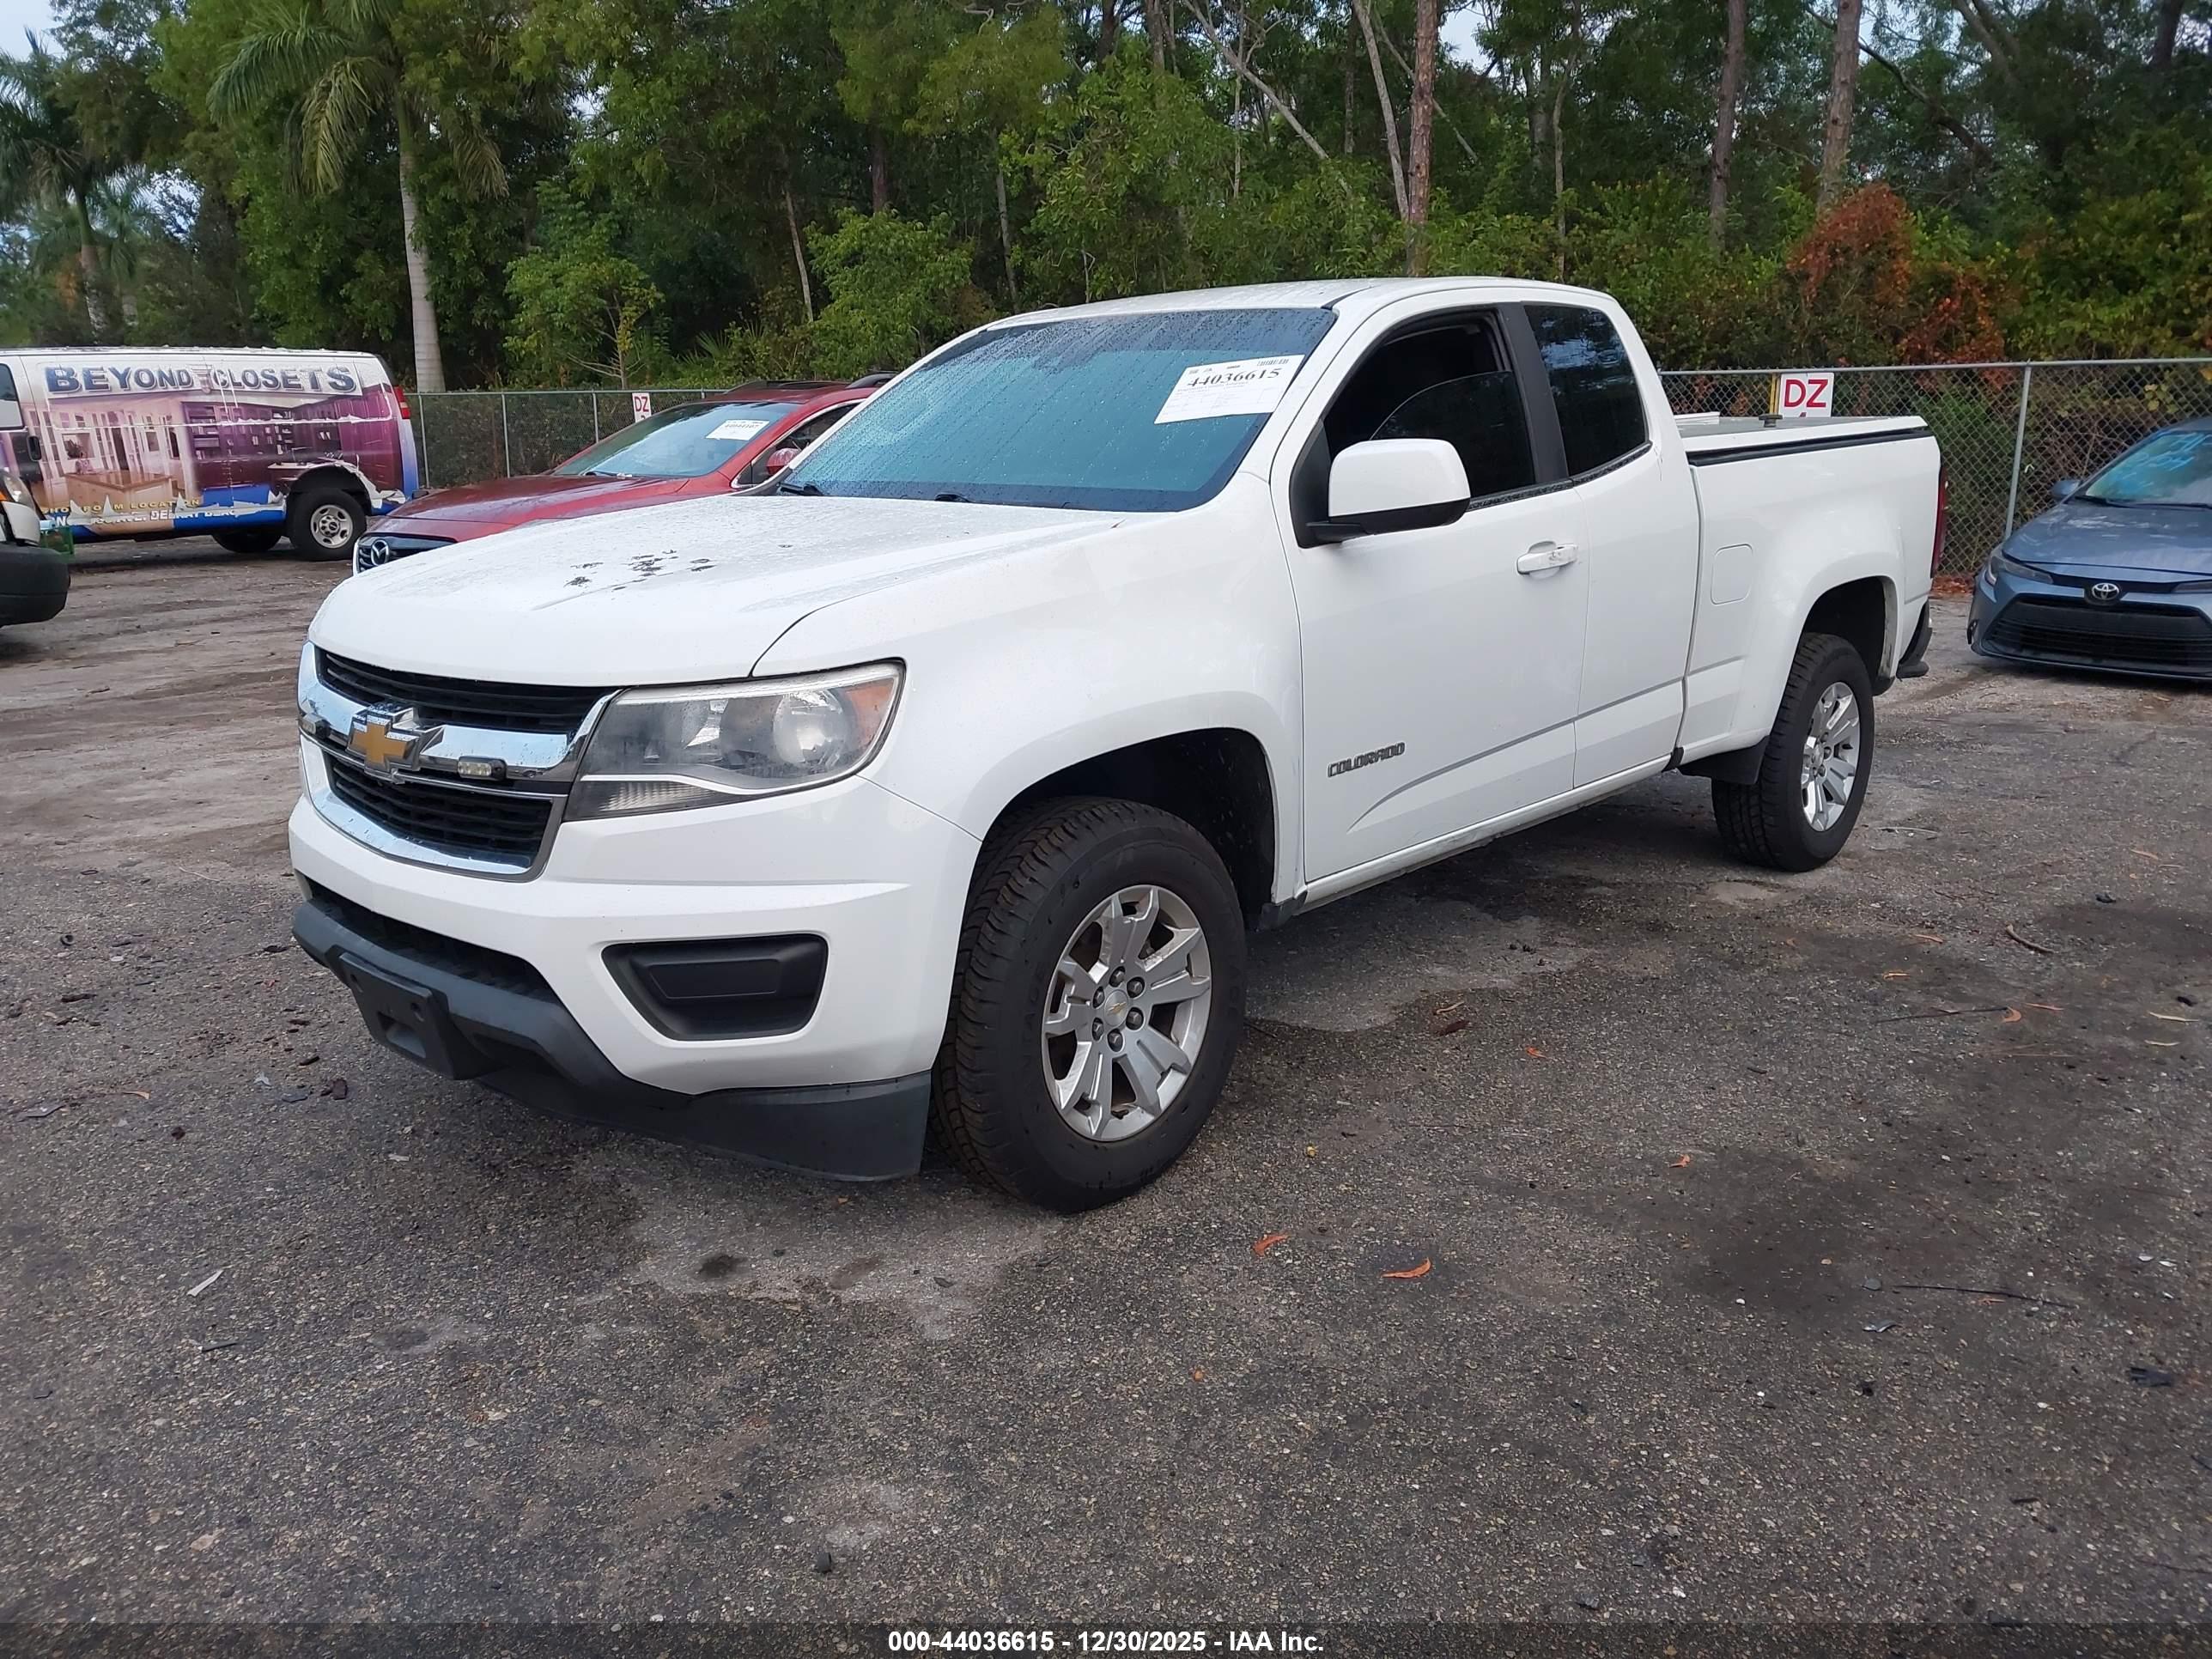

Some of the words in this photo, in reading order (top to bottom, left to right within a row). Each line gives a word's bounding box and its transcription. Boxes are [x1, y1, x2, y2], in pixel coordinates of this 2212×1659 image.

[45, 365, 195, 394] BEYOND
[213, 365, 357, 393] CLOSETS
[1188, 368, 1282, 387] 44036615
[634, 396, 649, 412] DZ
[1784, 379, 1829, 408] DZ
[1328, 741, 1406, 778] COLORADO
